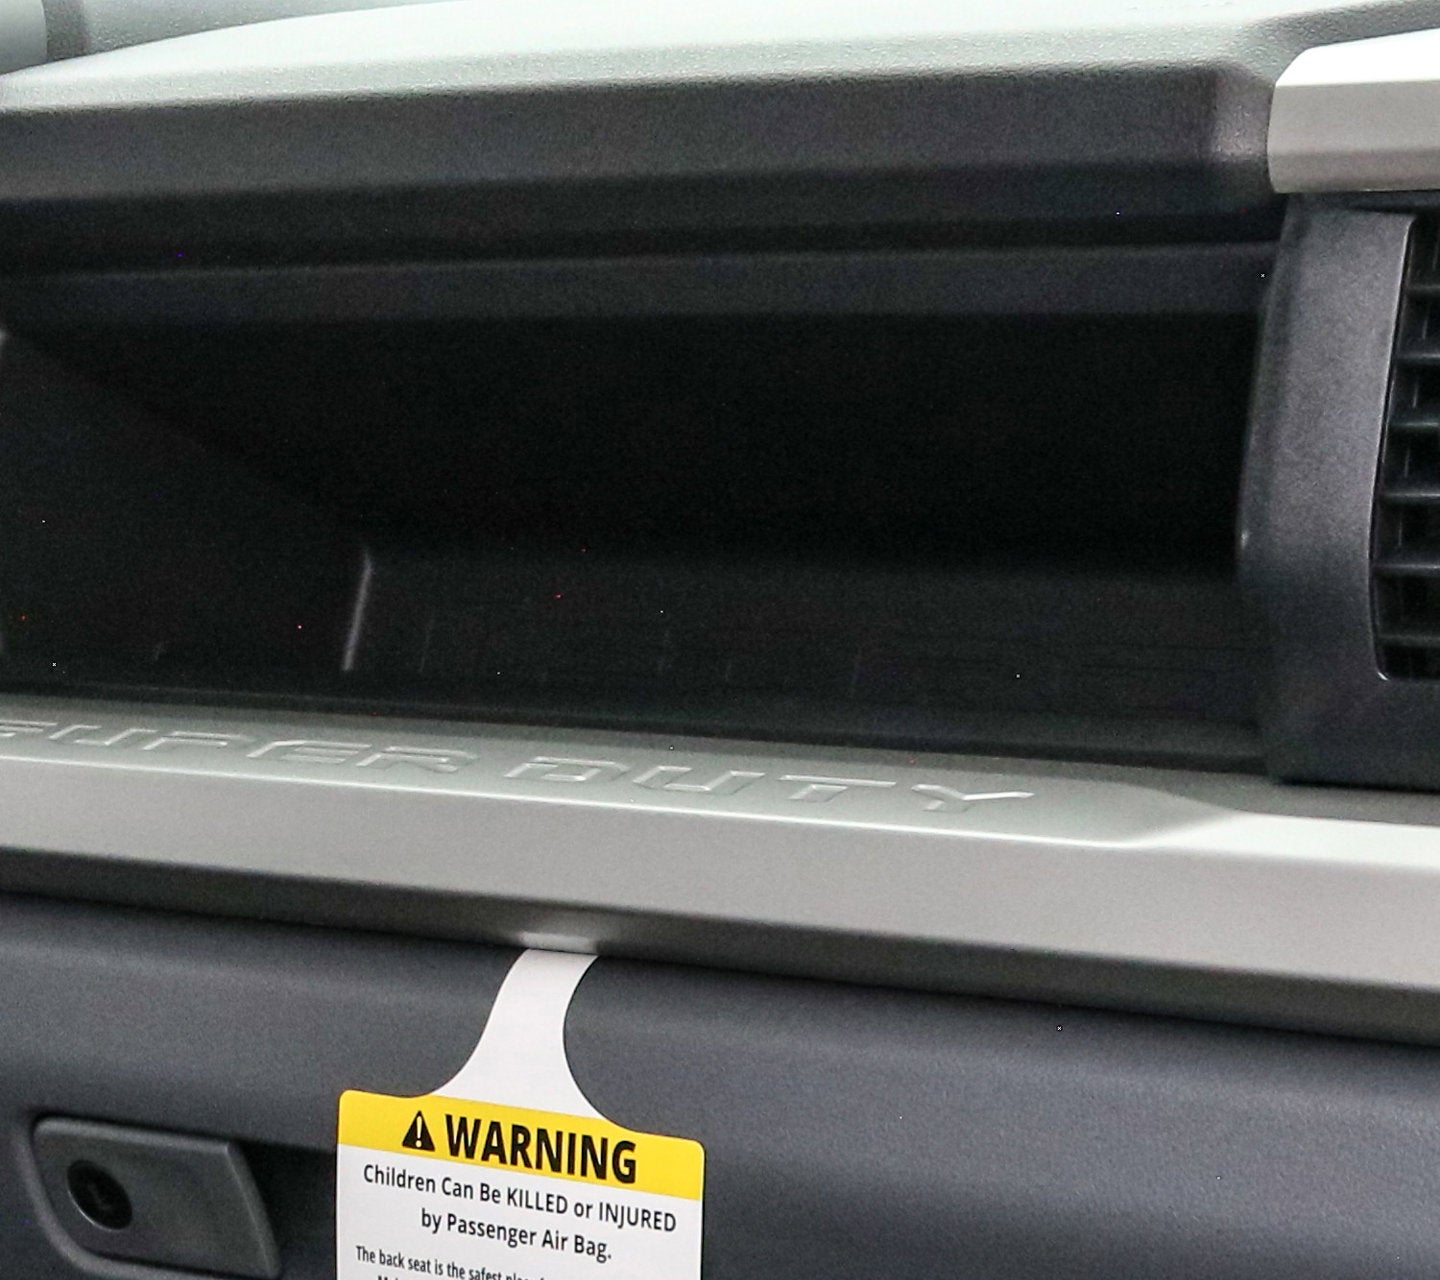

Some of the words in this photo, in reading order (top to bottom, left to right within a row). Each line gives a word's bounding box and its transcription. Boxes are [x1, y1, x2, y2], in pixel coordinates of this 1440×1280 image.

[503, 755, 1036, 813] DUTY
[445, 1113, 637, 1185] WARNING
[363, 1164, 436, 1194] Children
[441, 1176, 474, 1200] Can
[480, 1182, 502, 1204] Be
[507, 1188, 568, 1215] KILLED
[574, 1202, 594, 1220] or
[599, 1201, 677, 1233] INJURED
[356, 1245, 376, 1264] The
[379, 1249, 405, 1269] back
[408, 1258, 431, 1274] seat
[435, 1259, 444, 1276] is
[447, 1262, 466, 1280] the
[421, 1207, 442, 1236] by
[447, 1213, 537, 1249] Passenger
[542, 1229, 569, 1252] Air
[574, 1235, 613, 1264] Bag.
